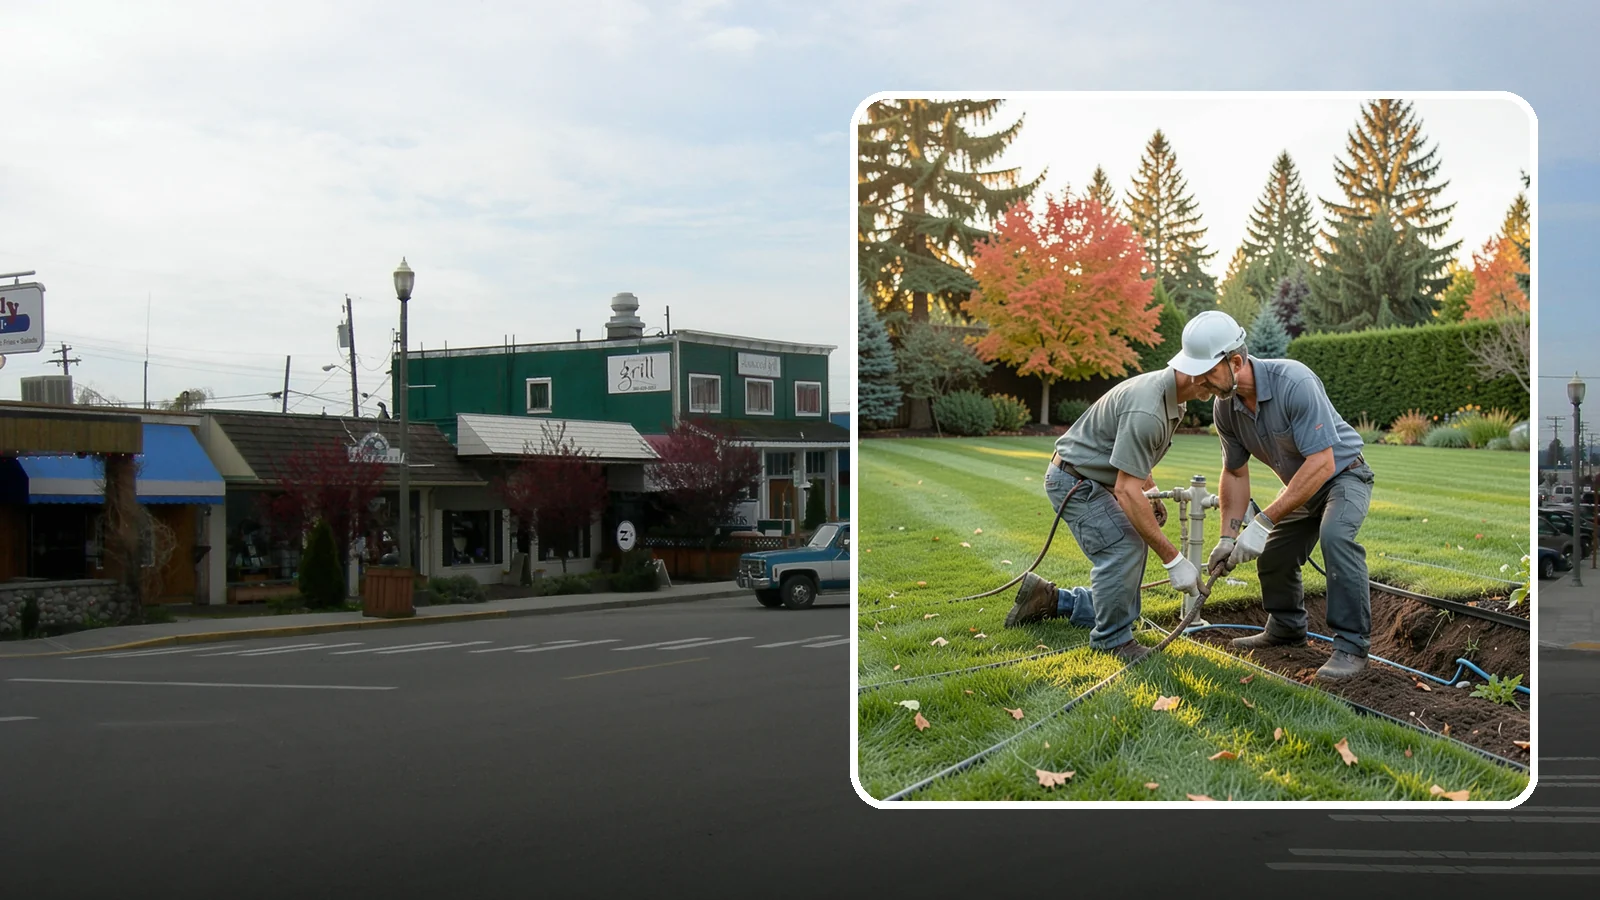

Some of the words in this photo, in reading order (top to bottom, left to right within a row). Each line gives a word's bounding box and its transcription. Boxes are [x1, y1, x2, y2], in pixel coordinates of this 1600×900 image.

[0, 297, 19, 323] ly
[20, 336, 38, 344] Salads
[618, 356, 655, 391] grill
